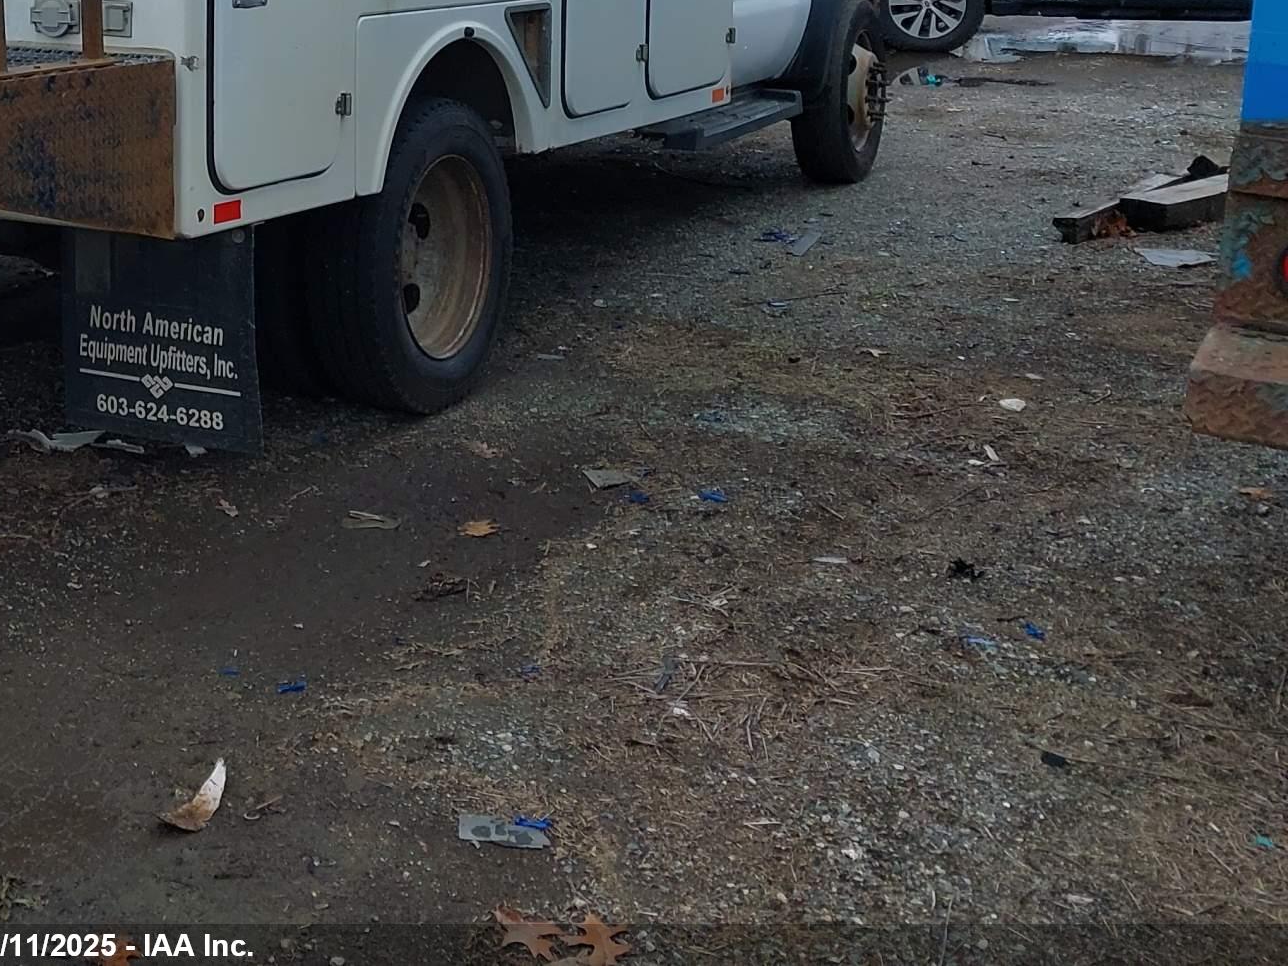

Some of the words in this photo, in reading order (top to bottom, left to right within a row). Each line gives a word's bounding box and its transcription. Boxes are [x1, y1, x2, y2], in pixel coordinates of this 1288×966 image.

[89, 304, 136, 333] North
[142, 311, 224, 347] American
[79, 333, 148, 365] Equipment
[150, 343, 211, 380] Upfitters,
[213, 353, 239, 380] Inc.
[96, 393, 224, 431] 603-624-6288
